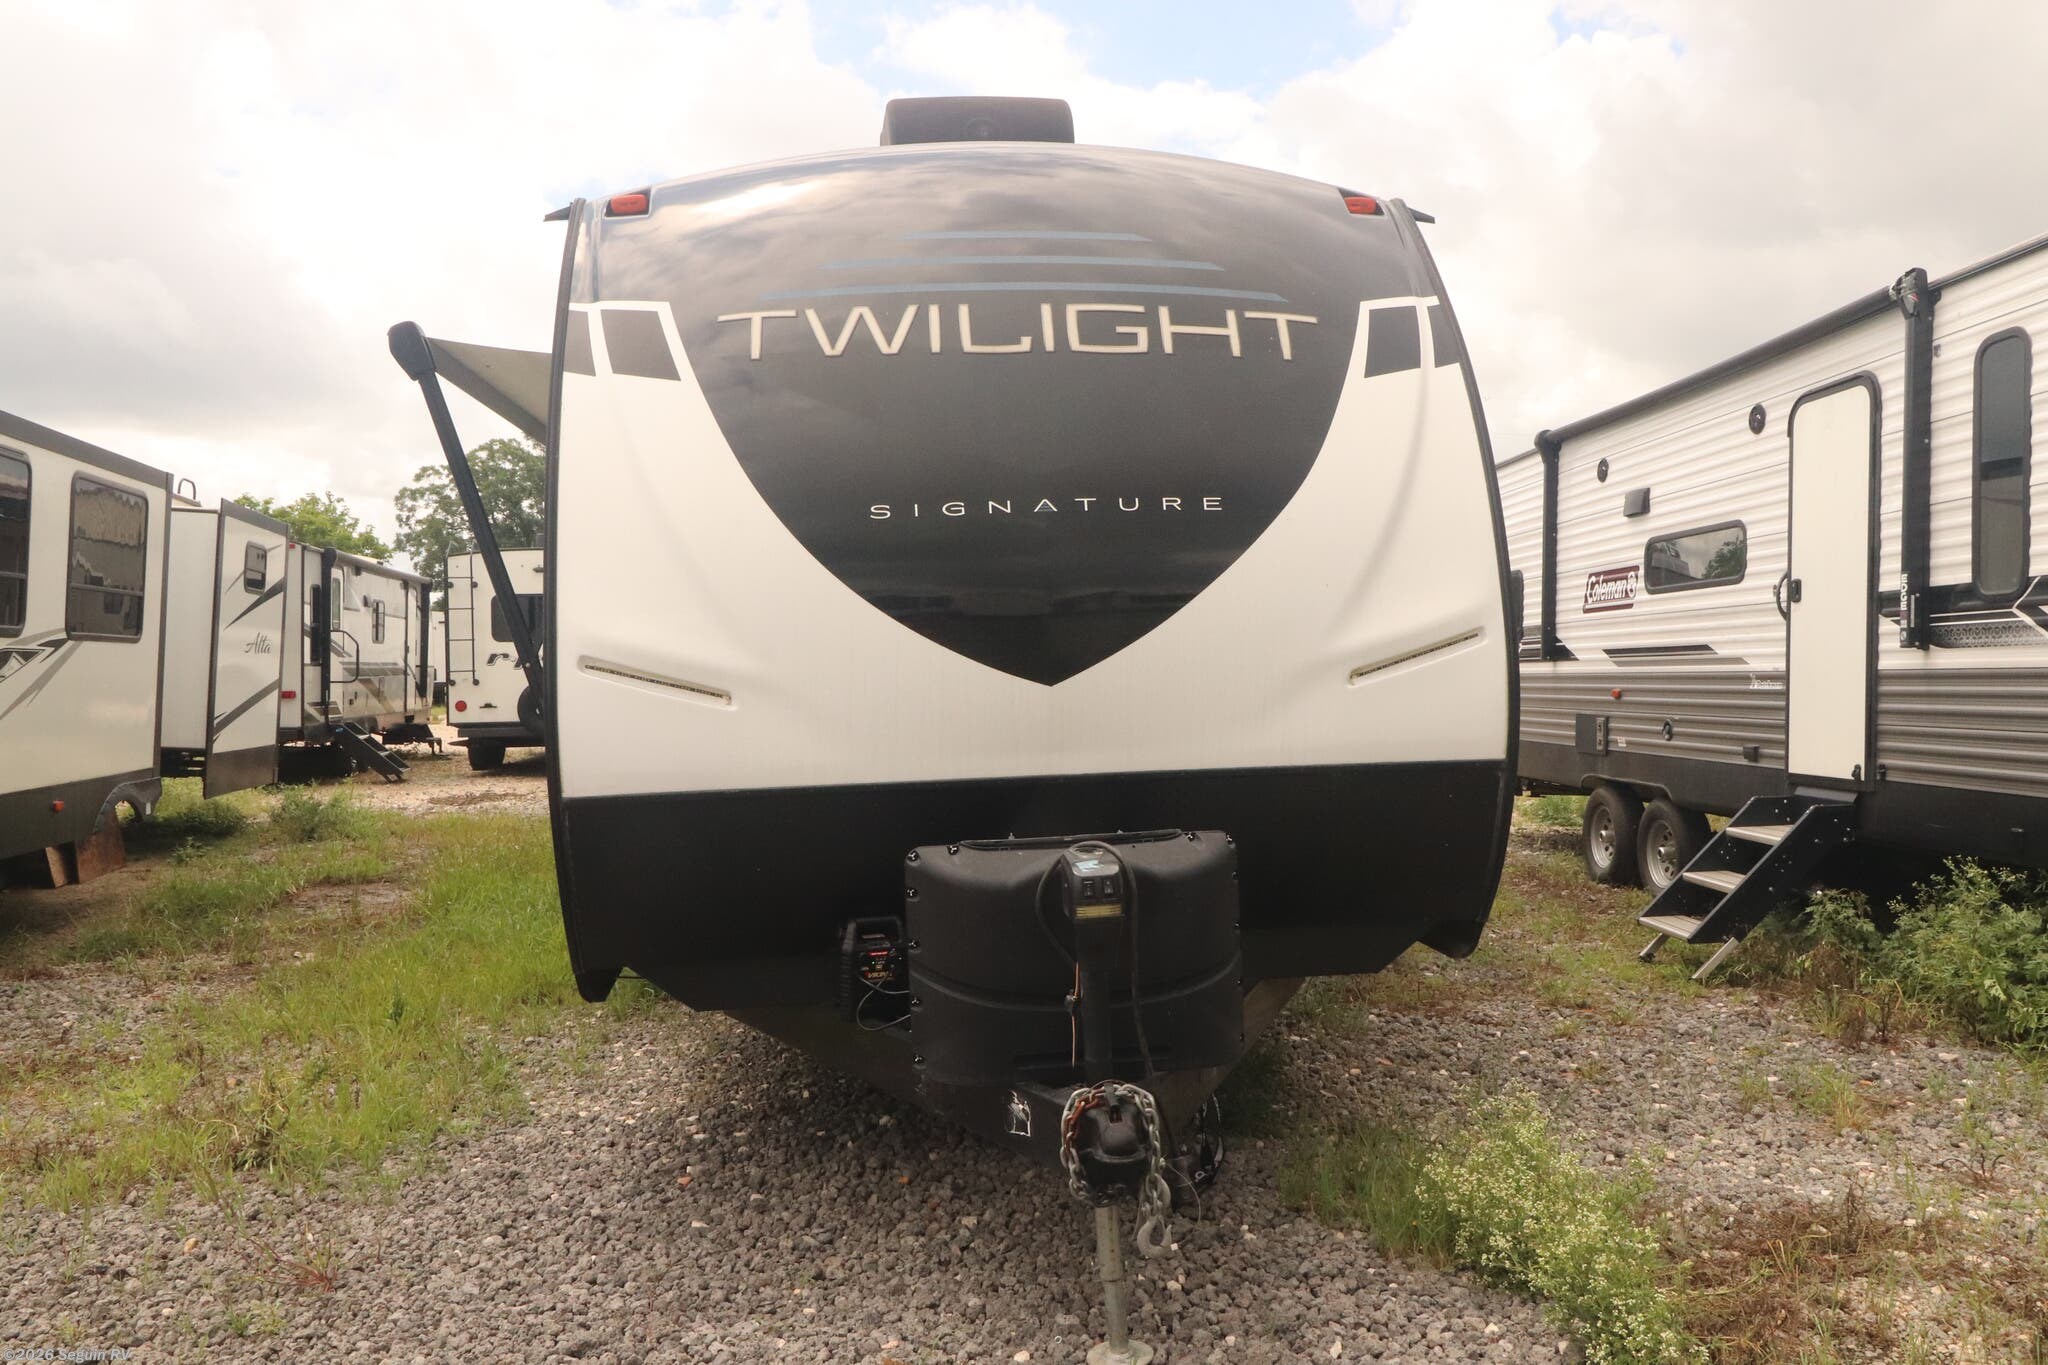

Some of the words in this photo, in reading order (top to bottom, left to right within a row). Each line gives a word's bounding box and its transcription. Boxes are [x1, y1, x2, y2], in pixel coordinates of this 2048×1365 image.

[717, 303, 1318, 361] TWILIGHT
[869, 497, 1223, 520] SIGNATURE
[1586, 574, 1628, 605] Coleman
[244, 631, 271, 655] Alta
